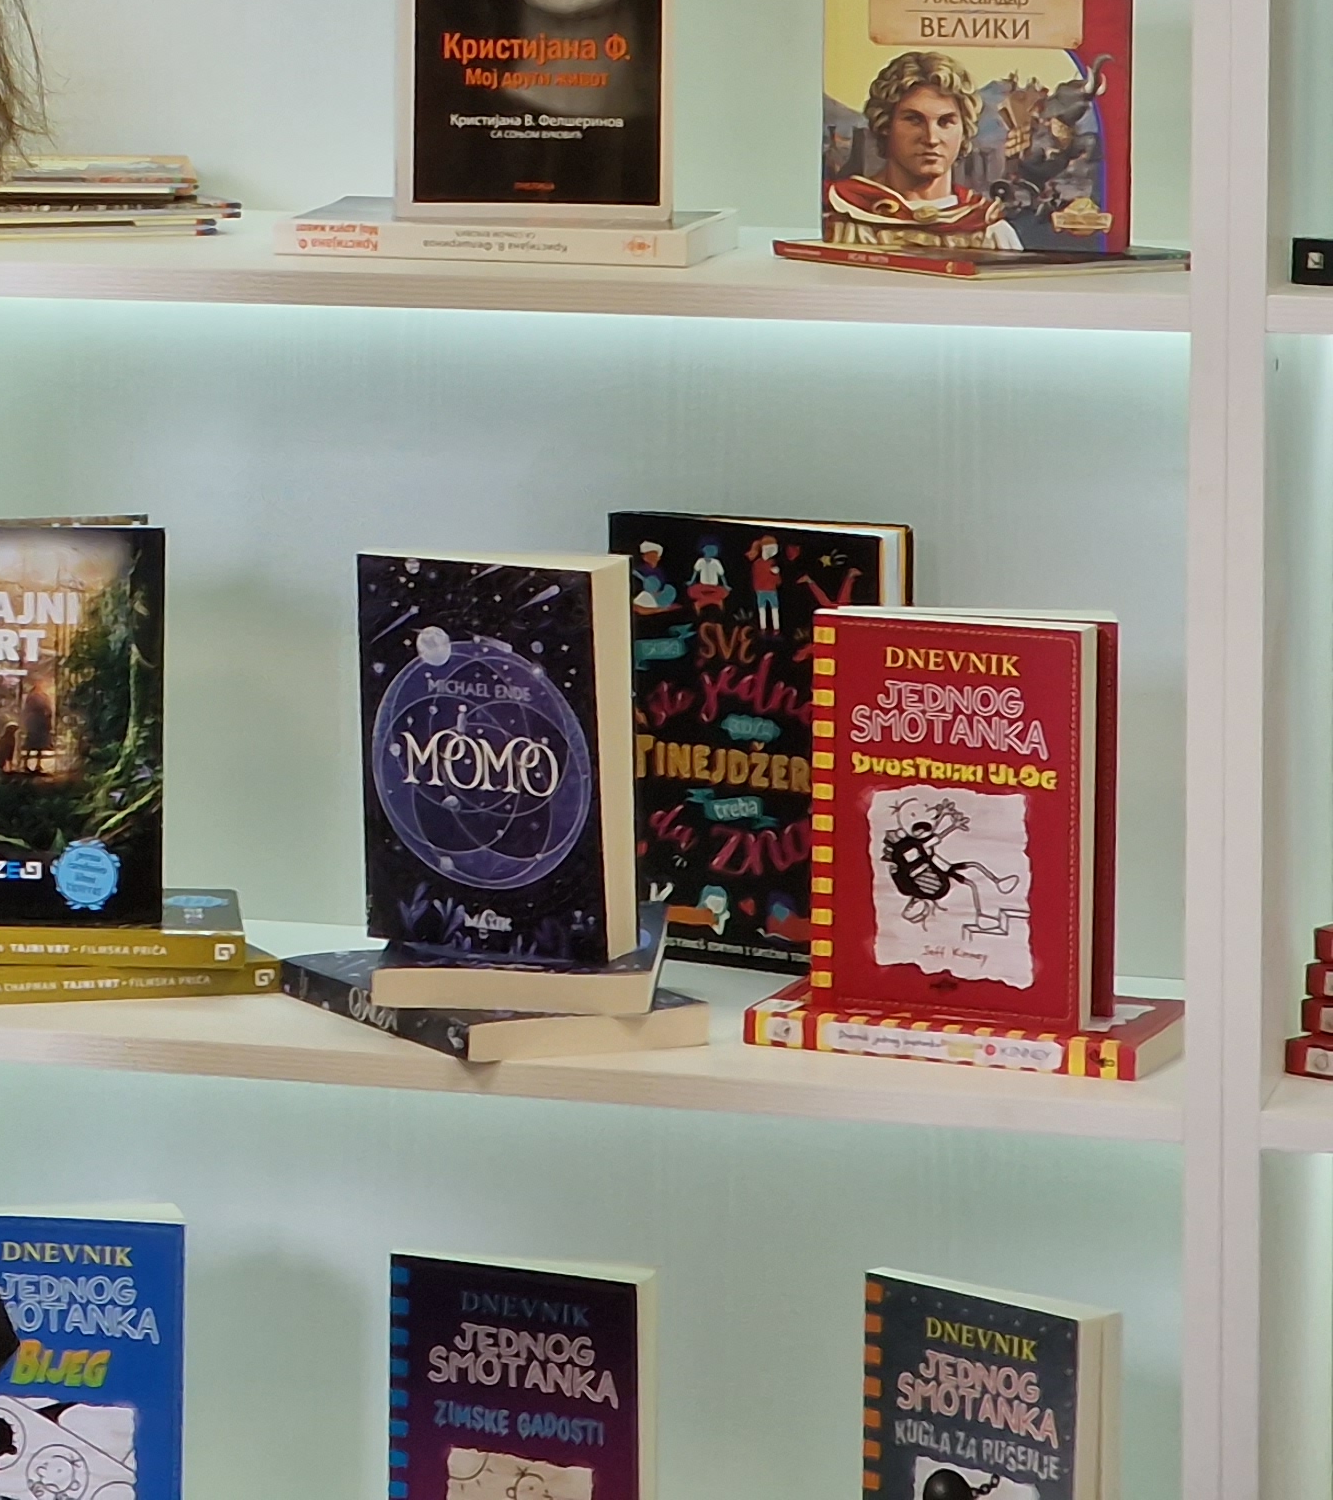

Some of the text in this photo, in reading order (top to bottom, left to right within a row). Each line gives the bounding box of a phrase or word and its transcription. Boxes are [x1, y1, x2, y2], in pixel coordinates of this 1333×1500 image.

[442, 32, 631, 65] Кристијана Ф.
[919, 16, 1031, 40] ВЕЛИКИ
[464, 67, 499, 89] Мој
[449, 113, 523, 128] Кристијана
[699, 621, 756, 665] SVE
[885, 646, 1021, 677] DNEVNIK
[427, 678, 532, 702] MICHAEL ENDE
[877, 679, 1024, 718] JEDNOG
[850, 704, 1050, 761] SMOTANKA
[400, 730, 560, 798] MOMO
[713, 801, 759, 818] treba
[1, 1241, 134, 1267] DNEVNIK
[461, 1290, 590, 1328] DNEVNIK
[453, 1321, 595, 1367] JEDNOG
[925, 1316, 1037, 1362] DNEVNIK
[9, 1338, 111, 1388] BIJEG
[426, 1345, 619, 1410] SMOTANKA
[919, 1349, 1041, 1404] JEDNOG
[434, 1399, 605, 1447] ZIMSKE GADOSTI
[895, 1371, 1059, 1449] SMOTANKA
[894, 1418, 1061, 1482] KUGLA ZA RUŠENJE
